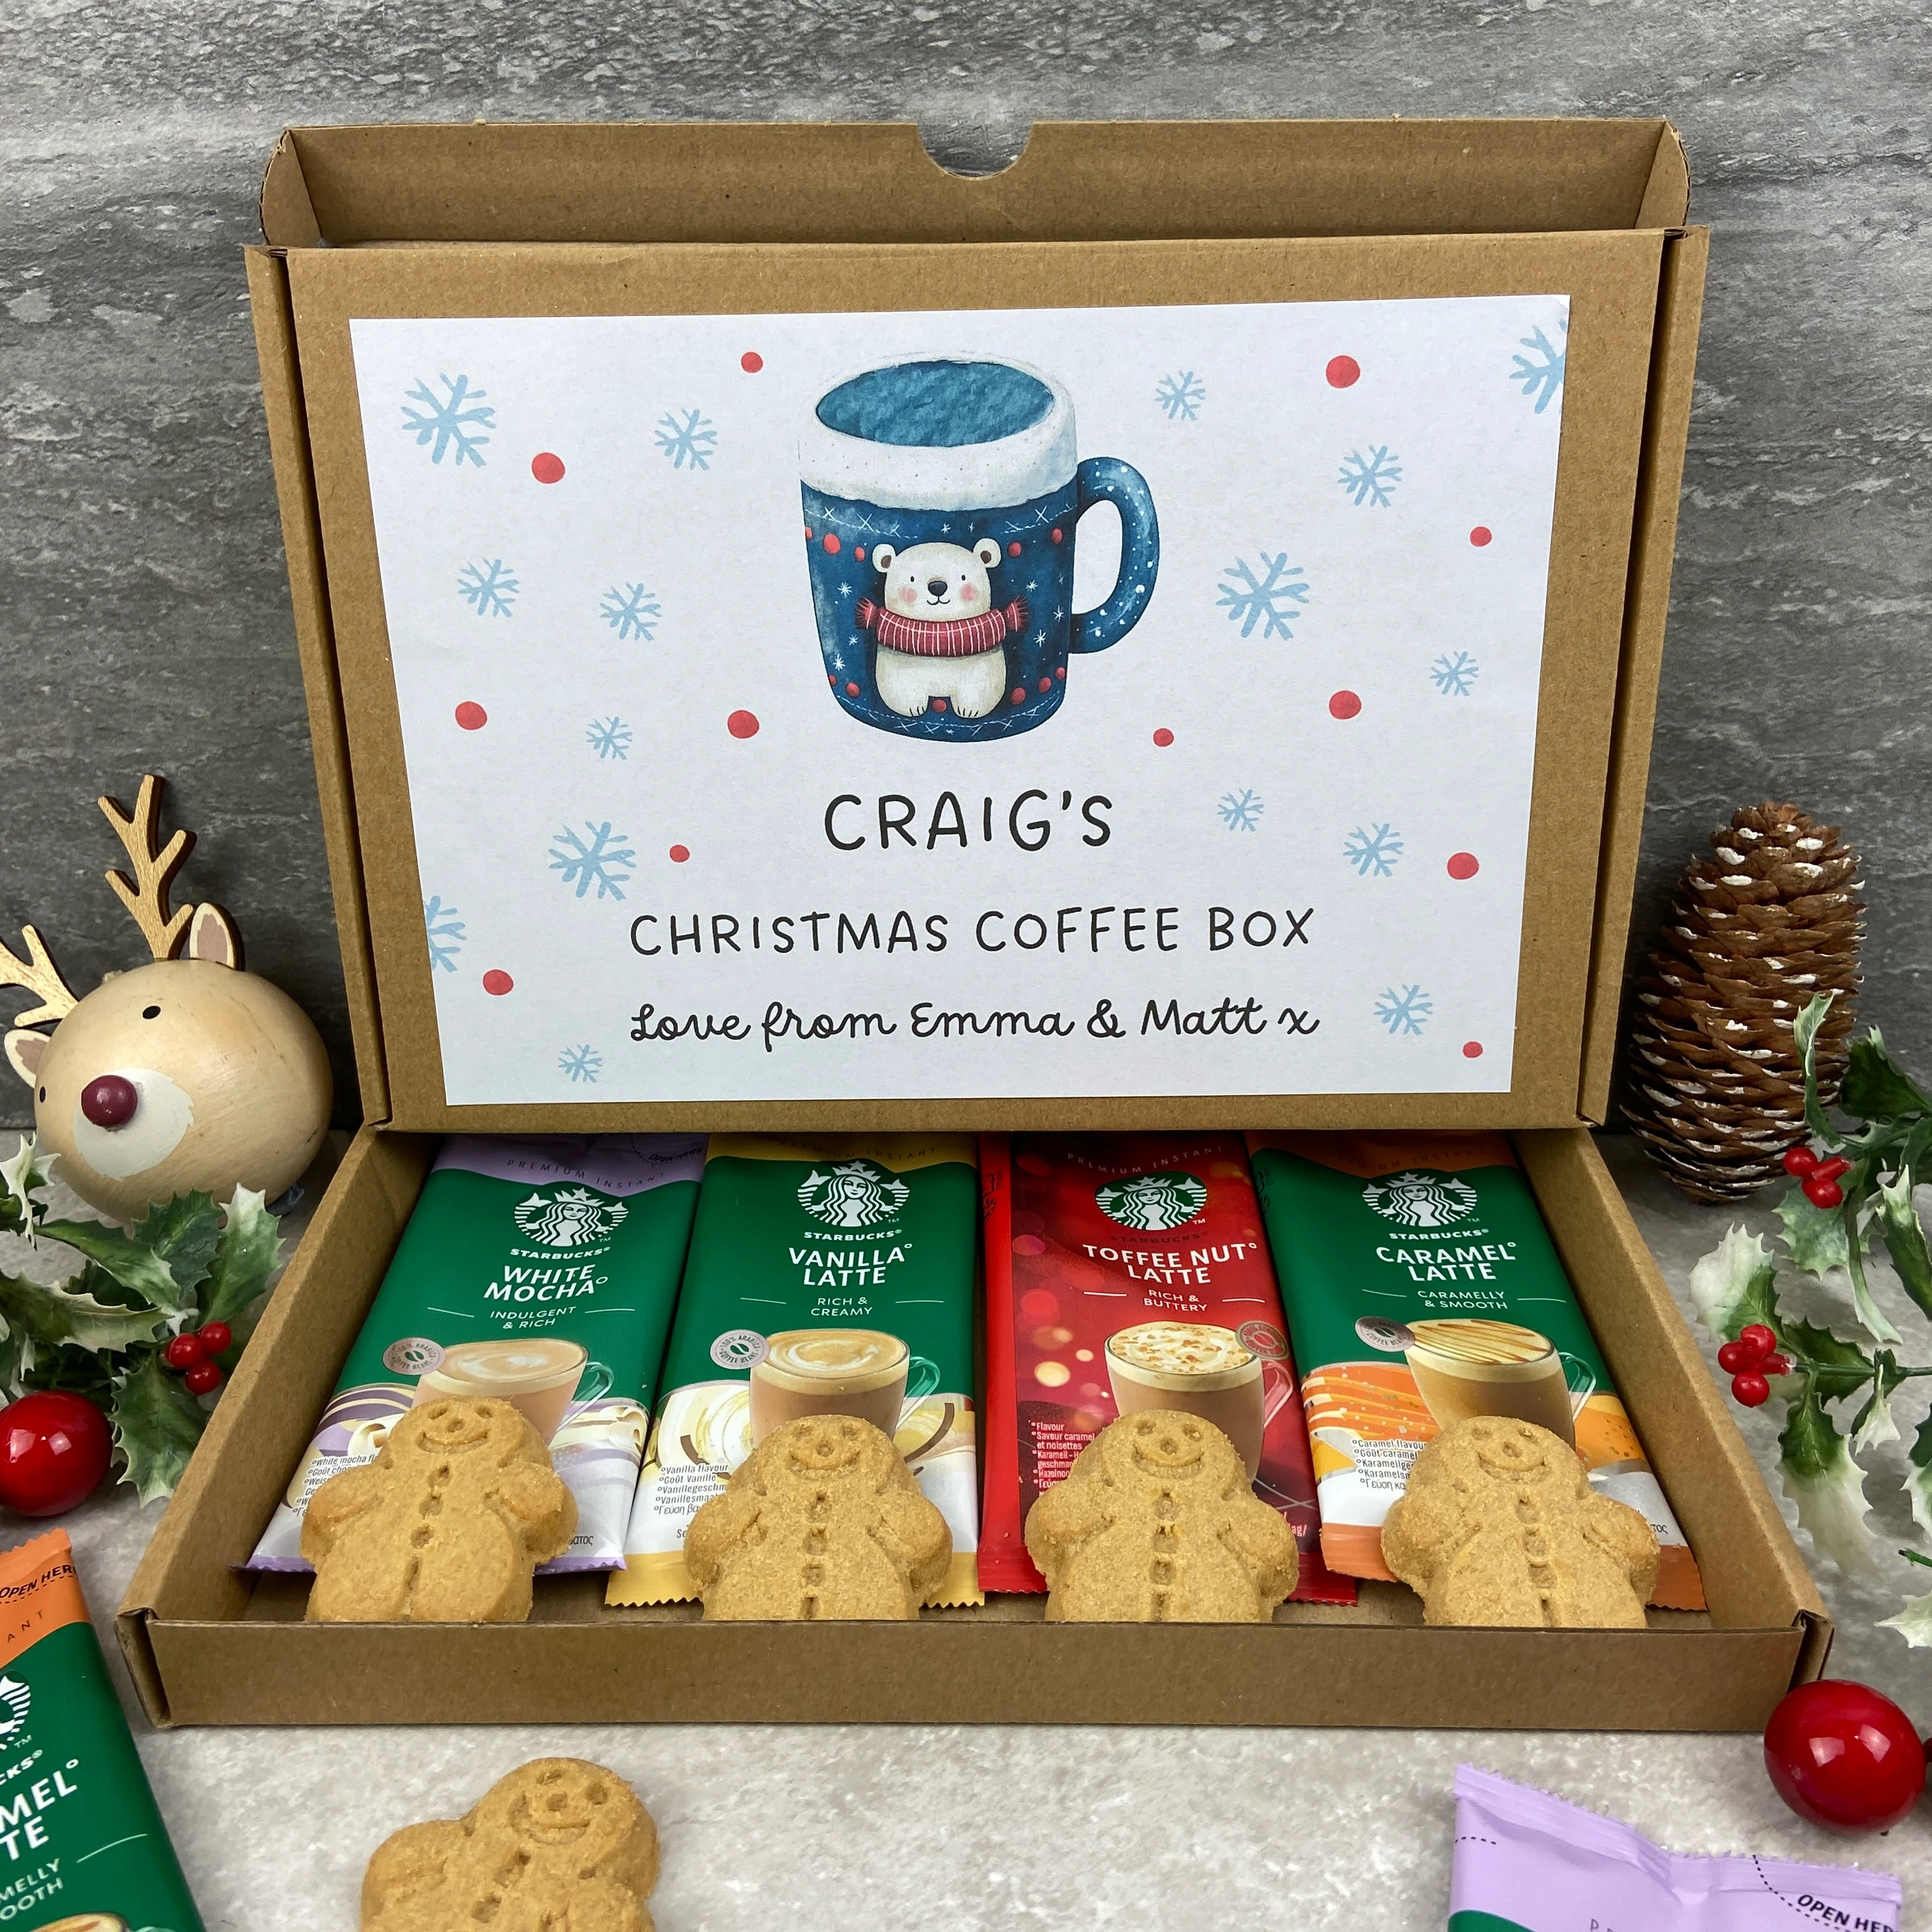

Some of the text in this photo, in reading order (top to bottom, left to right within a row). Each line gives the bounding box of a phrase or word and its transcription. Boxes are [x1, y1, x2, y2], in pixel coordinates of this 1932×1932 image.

[824, 790, 1114, 851] CRAIG'S
[630, 906, 1314, 955] CHRISTMAS COFFEE BOX
[630, 997, 1320, 1052] Love from Emma & Matt x
[1068, 1146, 1222, 1174] PREMIUM INSTANT
[507, 1159, 664, 1189] PREMIUM INSTANT
[1082, 1244, 1182, 1268] TOFFEE
[503, 1264, 595, 1285] WHITE
[803, 1266, 886, 1287] LATTE
[1128, 1264, 1211, 1284] LATTE
[1408, 1262, 1496, 1282] LATTE
[1149, 1289, 1183, 1301] RICH
[1418, 1290, 1505, 1299] CARAMELLY
[811, 1307, 873, 1316] CREAMY
[1144, 1298, 1208, 1312] BUTTERY
[1441, 1300, 1508, 1309] SMOOTH
[490, 1307, 576, 1320] INDULGENT
[519, 1318, 556, 1328] RICH
[719, 1351, 758, 1363] COFFEE BEANS
[1046, 1441, 1082, 1450] noisettes
[339, 1455, 366, 1464] mocha
[1383, 1450, 1417, 1460] caramel
[698, 1464, 728, 1473] flavour
[687, 1475, 716, 1483] Vanille
[0, 1579, 37, 1598] OPEN
[1797, 1894, 1850, 1926] OPEN
